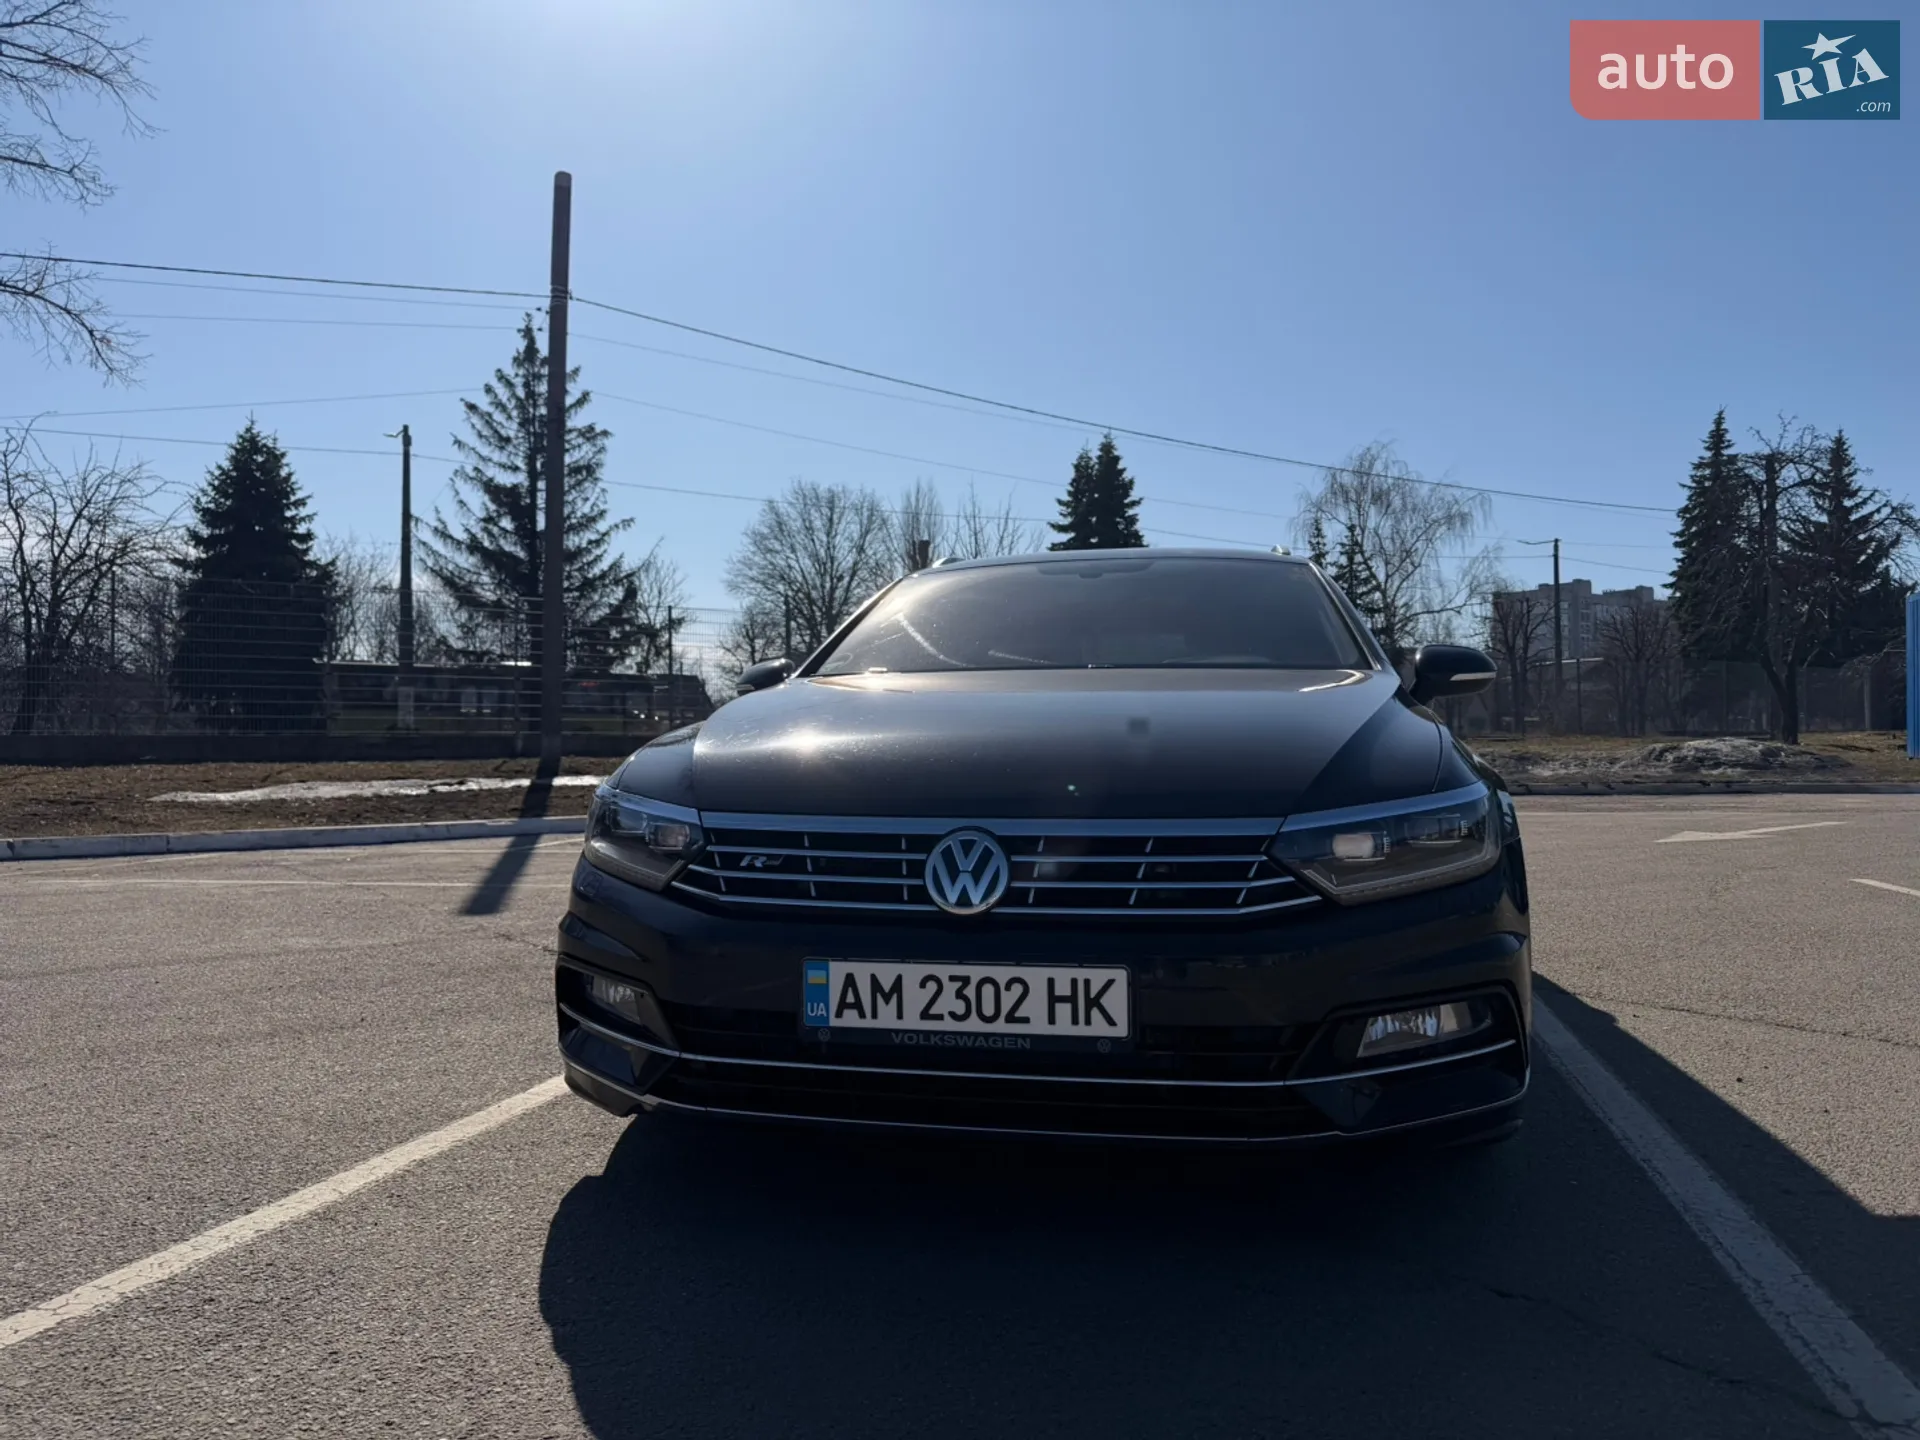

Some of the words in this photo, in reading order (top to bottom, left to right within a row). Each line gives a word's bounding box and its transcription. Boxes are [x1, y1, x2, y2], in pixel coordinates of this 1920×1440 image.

[834, 972, 904, 1021] AM
[918, 973, 1031, 1024] 2302
[1047, 976, 1118, 1027] HK
[807, 1002, 828, 1017] UA
[891, 1031, 1031, 1050] VOLKSWAGEN
